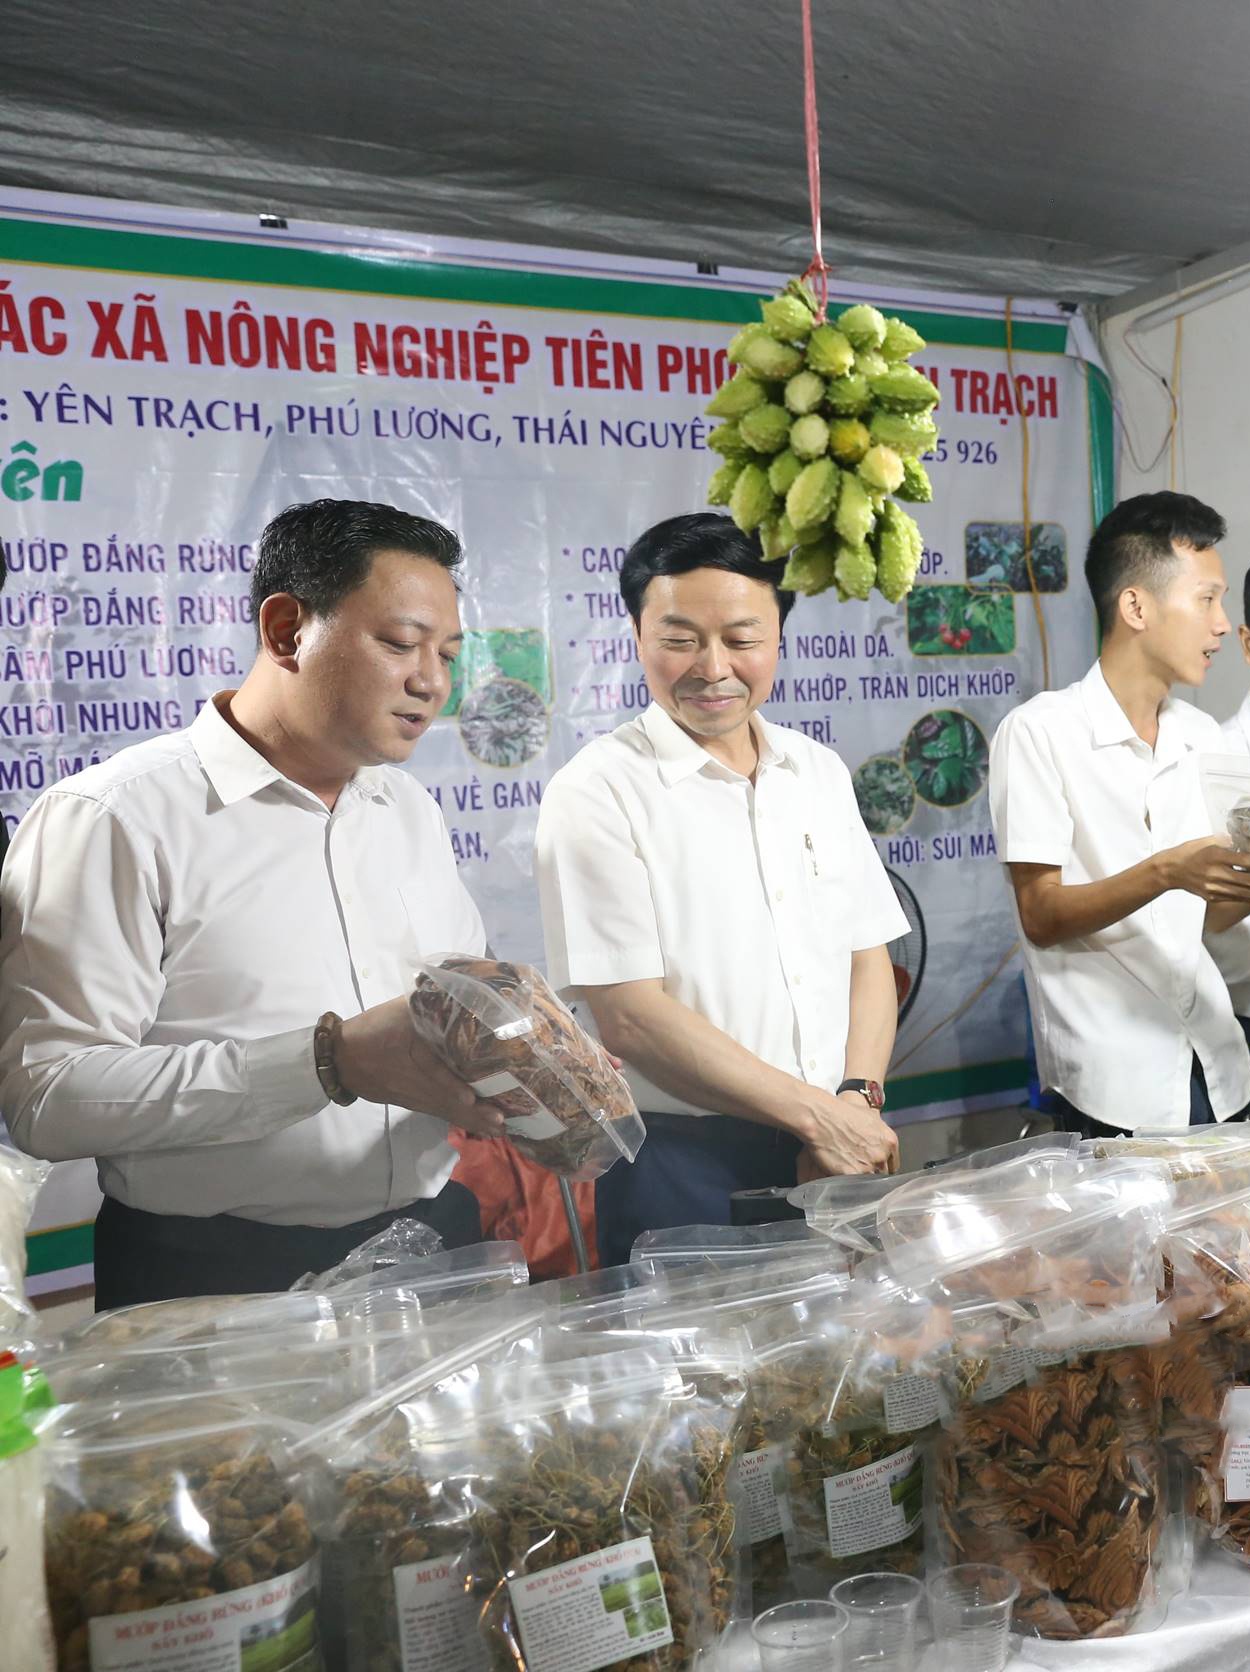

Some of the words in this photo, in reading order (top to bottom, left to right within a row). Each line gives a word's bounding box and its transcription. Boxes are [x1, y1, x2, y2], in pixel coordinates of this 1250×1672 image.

[87, 293, 169, 362] XÃ
[185, 300, 337, 373] NÔNG
[354, 320, 531, 395] NGHIỆP
[545, 329, 643, 391] TIÊN
[950, 368, 1058, 426] TRẠCH
[23, 383, 113, 426] YÊN
[127, 396, 273, 439] TRẠCH,
[286, 398, 360, 437] PHÚ
[374, 406, 502, 448] LƯƠNG,
[512, 409, 588, 446] THÁI
[957, 440, 998, 465] 926
[83, 534, 165, 573] ĐẮNG
[0, 591, 70, 627] ƯỚP
[84, 587, 165, 626] ĐẮNG
[0, 645, 52, 682] ÂM
[66, 644, 127, 681] PHÚ
[141, 644, 244, 680] LƯƠNG.
[797, 630, 855, 659] NGOÀI
[865, 635, 894, 658] DA.
[591, 676, 653, 709] THUỐ
[793, 671, 852, 704] KHỚP,
[860, 672, 908, 700] TRÀN
[917, 675, 959, 702] DỊCH
[967, 668, 1020, 696] KHỚP.
[78, 700, 183, 733] NHUNG
[453, 775, 484, 812] VỀ
[888, 836, 925, 869] HỘI:
[933, 833, 961, 860] SÙI
